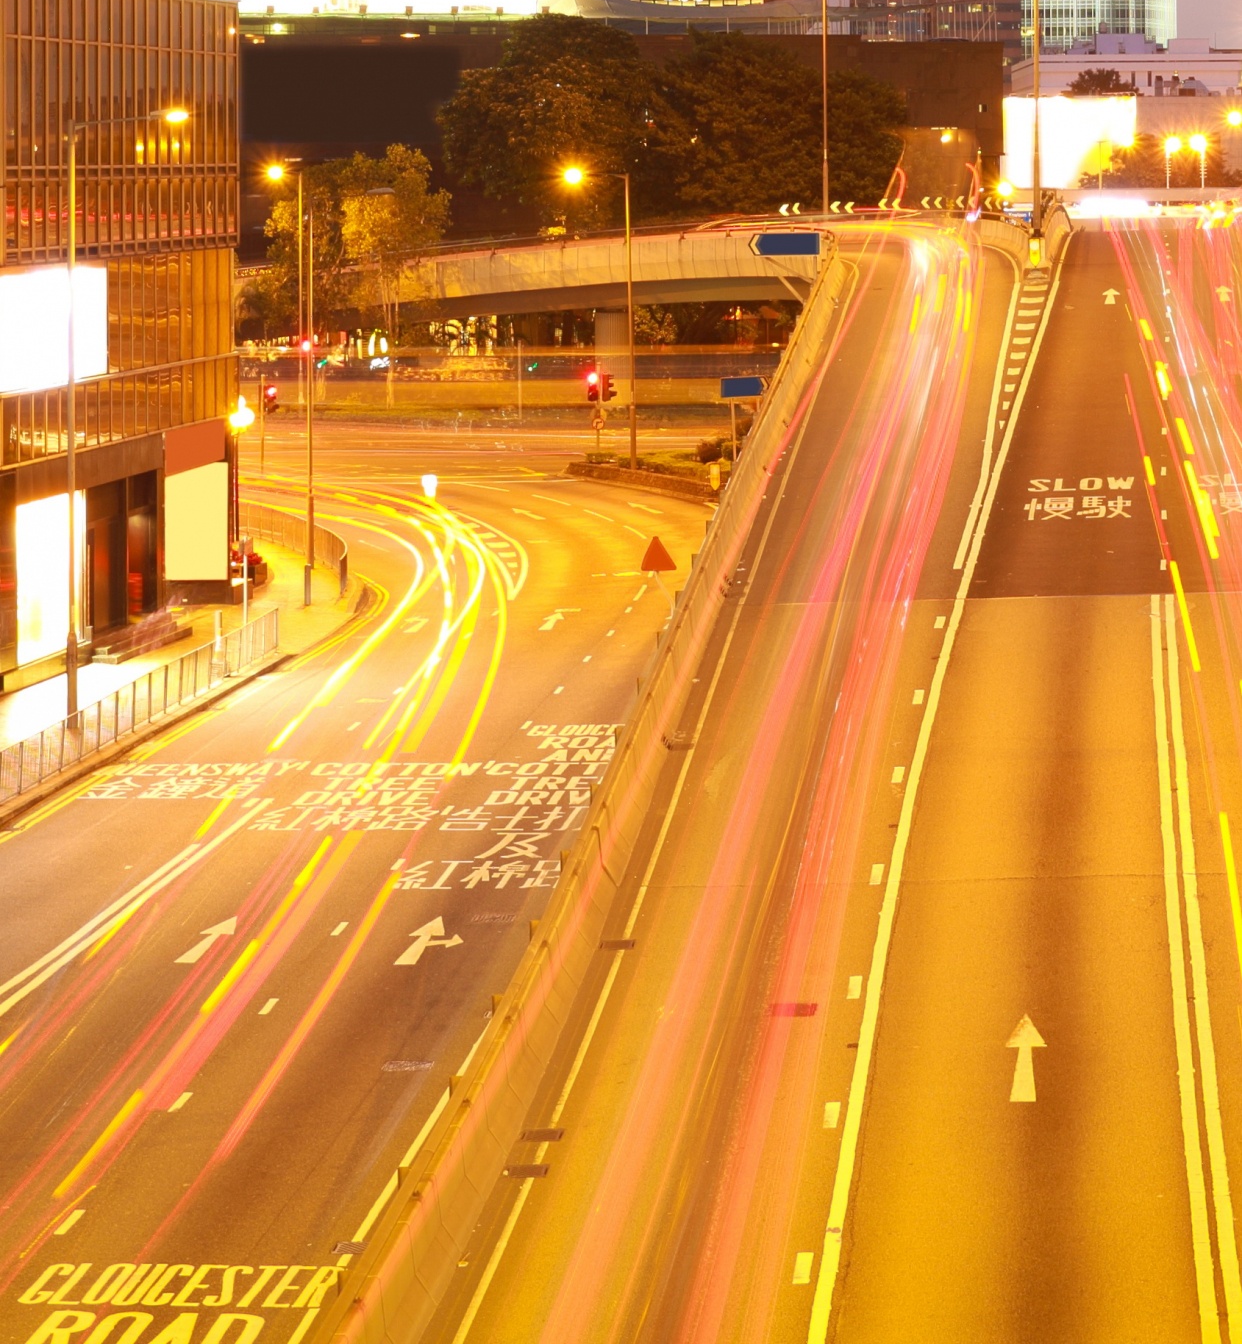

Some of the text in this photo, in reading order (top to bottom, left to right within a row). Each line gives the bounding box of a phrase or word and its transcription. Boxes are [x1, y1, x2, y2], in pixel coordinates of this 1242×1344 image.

[1027, 476, 1135, 492] SLOW
[1024, 495, 1132, 521] 慢駛
[310, 762, 482, 777] COTTON
[324, 777, 444, 791] TREE
[291, 790, 440, 806] DRIVE
[247, 806, 440, 832] 紅棉路
[474, 832, 552, 859] 及
[17, 1262, 346, 1308] GLOUCESTER
